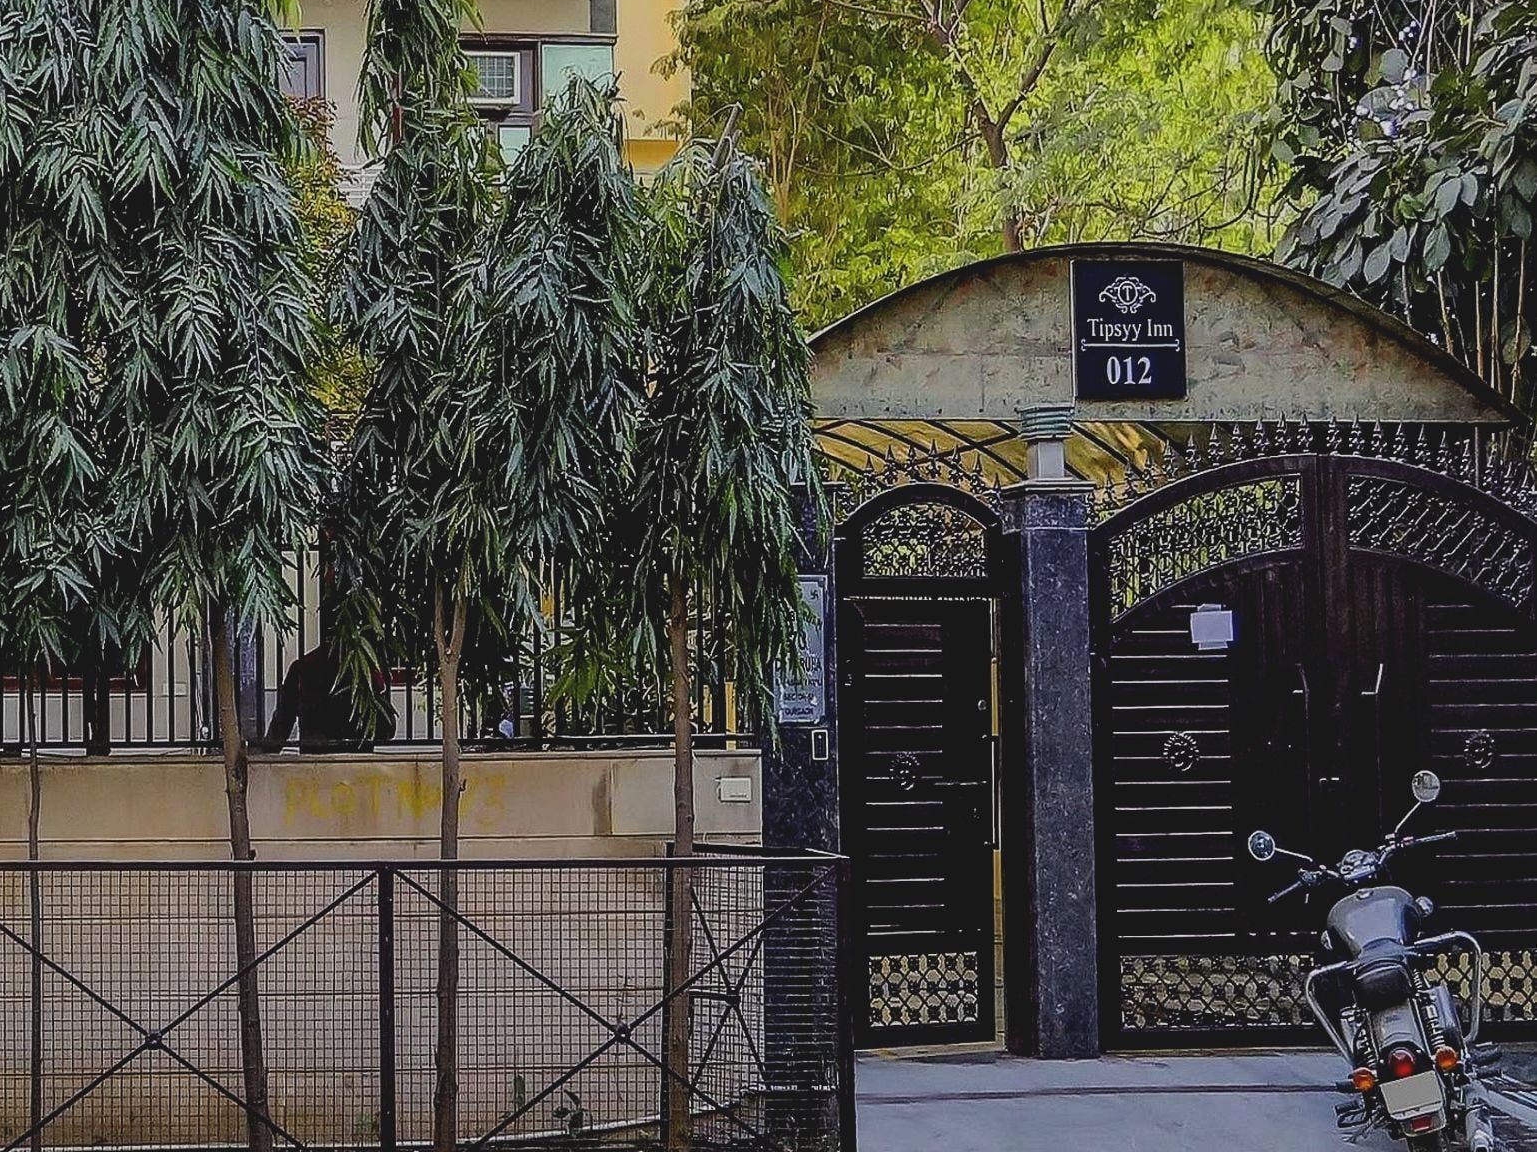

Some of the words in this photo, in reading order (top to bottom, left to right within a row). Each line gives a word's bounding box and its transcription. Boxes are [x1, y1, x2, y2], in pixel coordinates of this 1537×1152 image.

[1086, 317, 1142, 342] Tipsyy
[1147, 318, 1174, 337] Inn
[1105, 356, 1153, 385] 012
